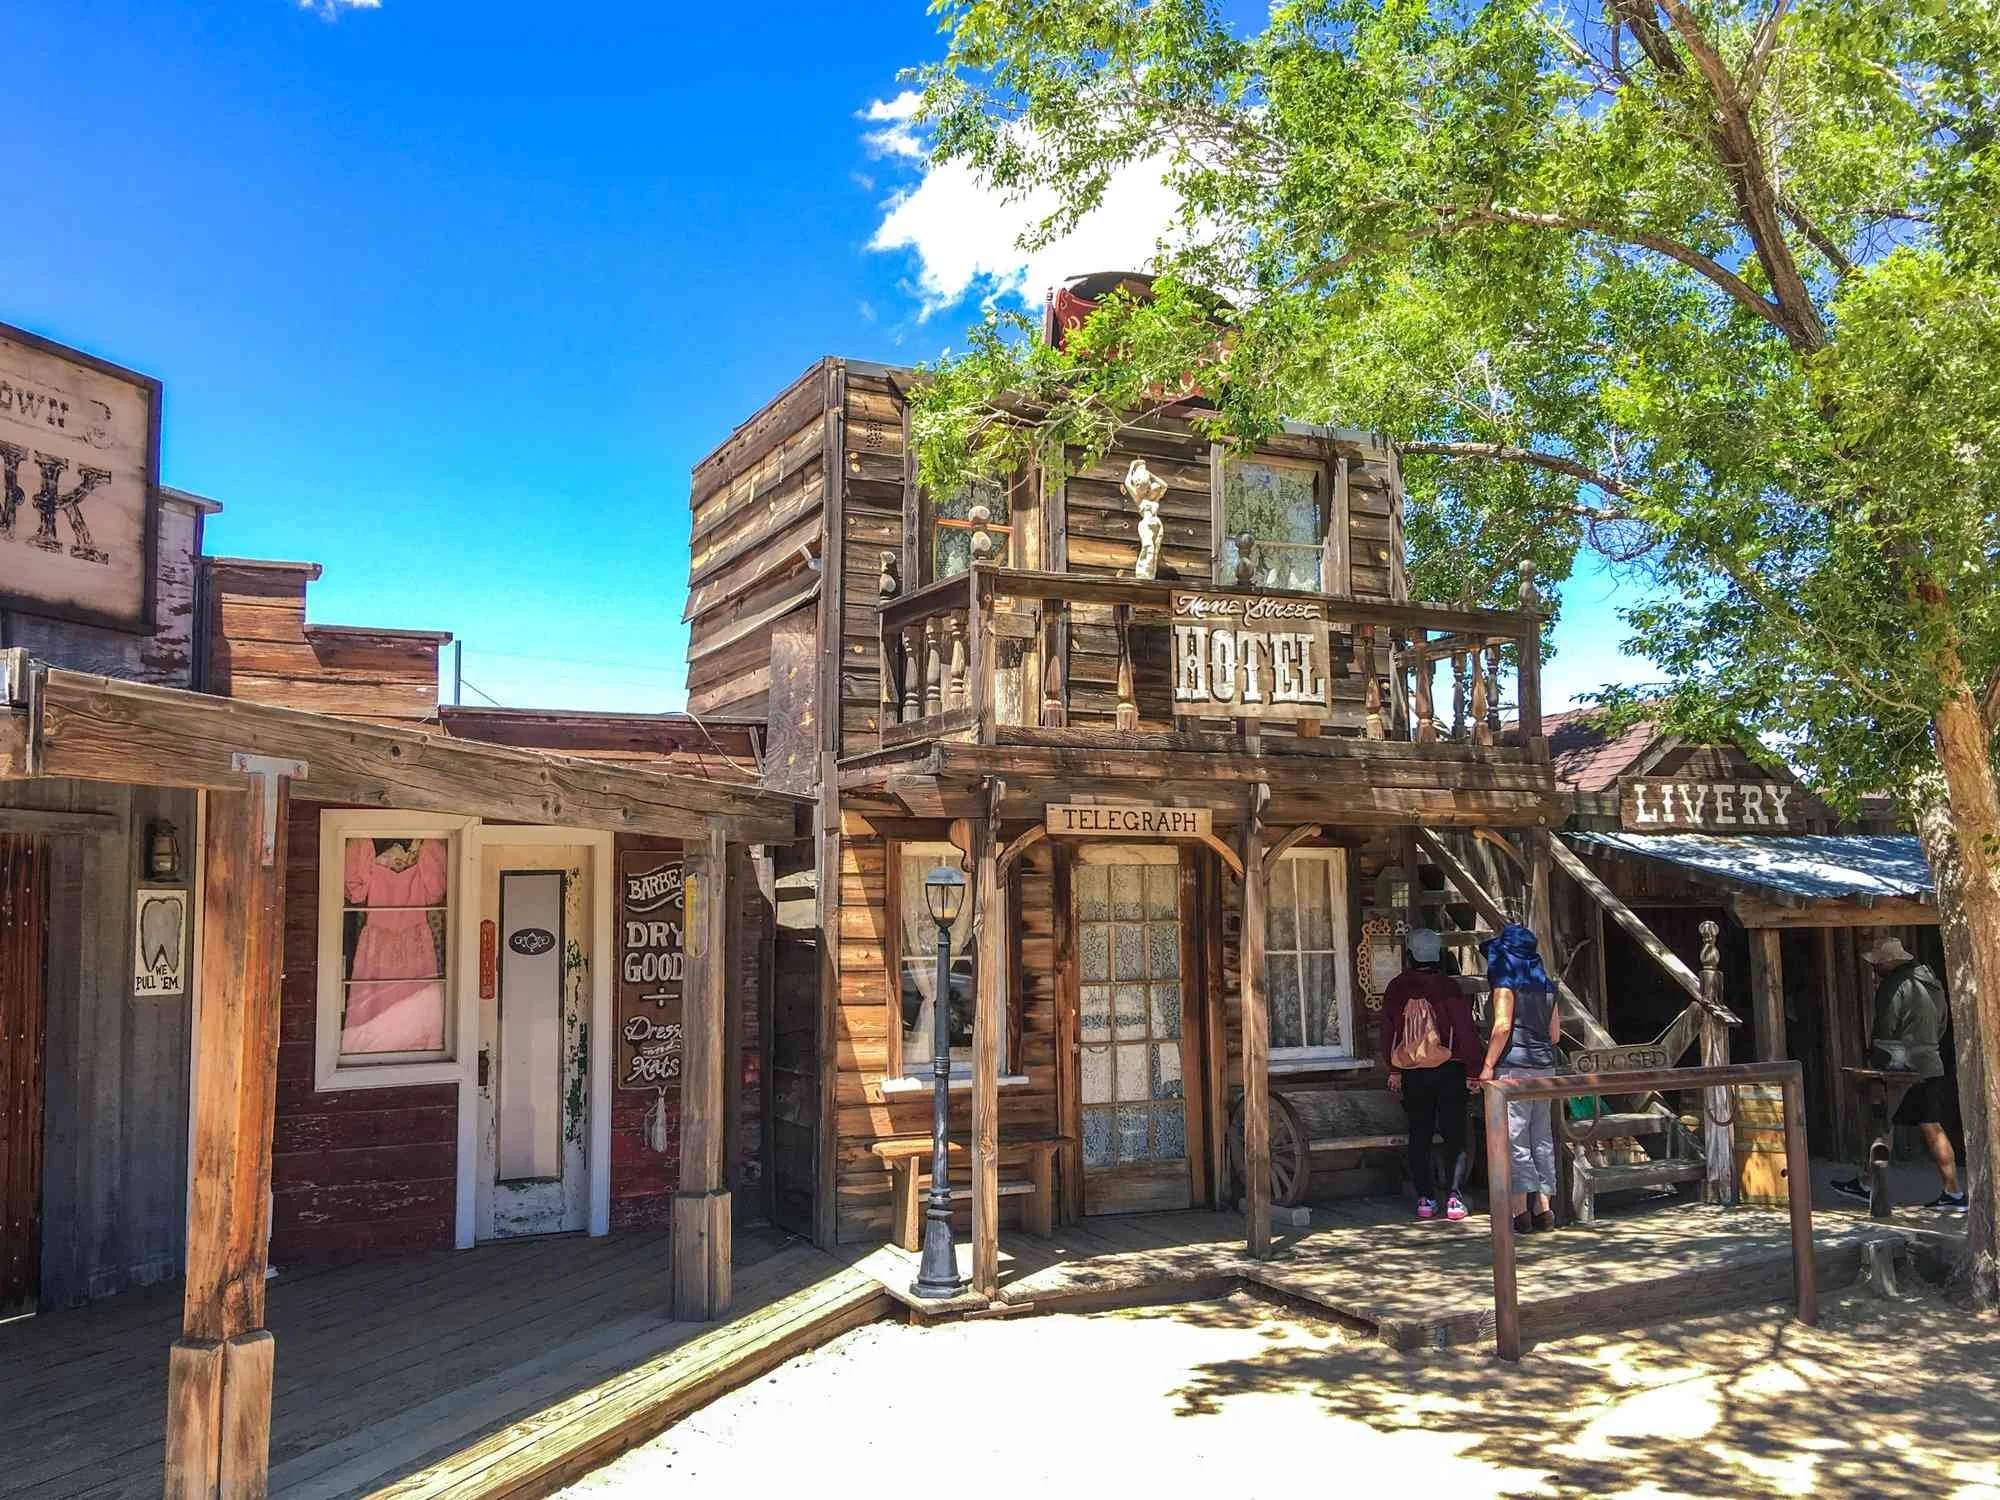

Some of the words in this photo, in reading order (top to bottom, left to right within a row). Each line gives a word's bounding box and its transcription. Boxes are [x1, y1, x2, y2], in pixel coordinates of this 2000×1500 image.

[1242, 596, 1321, 626] Street
[1173, 625, 1327, 705] HOTEL
[1633, 783, 1792, 825] LIVERY
[1062, 808, 1197, 833] TELEGRAPH
[628, 868, 684, 900] BARBE
[626, 921, 684, 948] DRY
[136, 975, 156, 990] PULL
[155, 964, 168, 976] WE
[624, 1015, 683, 1040] Dress
[627, 1056, 680, 1080] Hats
[1576, 1049, 1667, 1073] CLOSED
